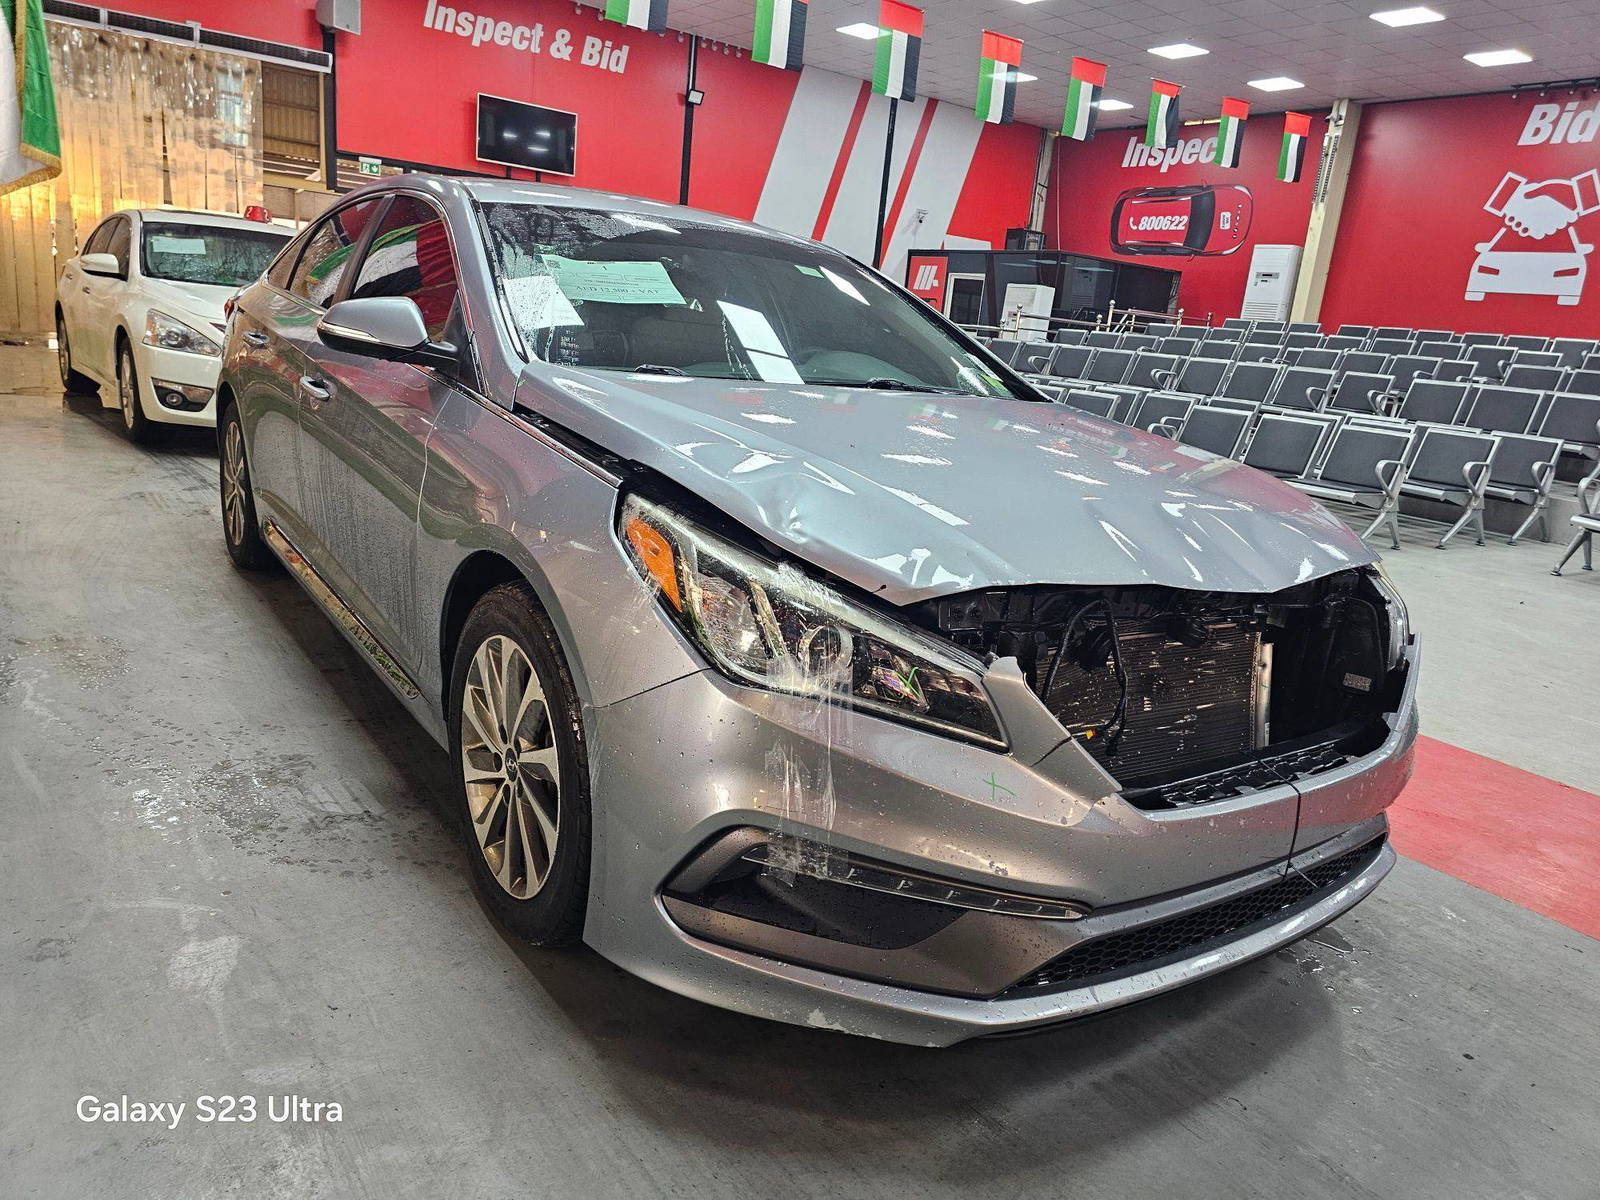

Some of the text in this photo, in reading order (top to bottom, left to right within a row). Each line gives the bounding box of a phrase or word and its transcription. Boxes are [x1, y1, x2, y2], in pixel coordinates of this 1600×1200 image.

[423, 0, 630, 74] Inspect & Bid
[1517, 101, 1600, 146] Bid
[1121, 136, 1219, 173] Inspec
[1138, 215, 1189, 231] 800622
